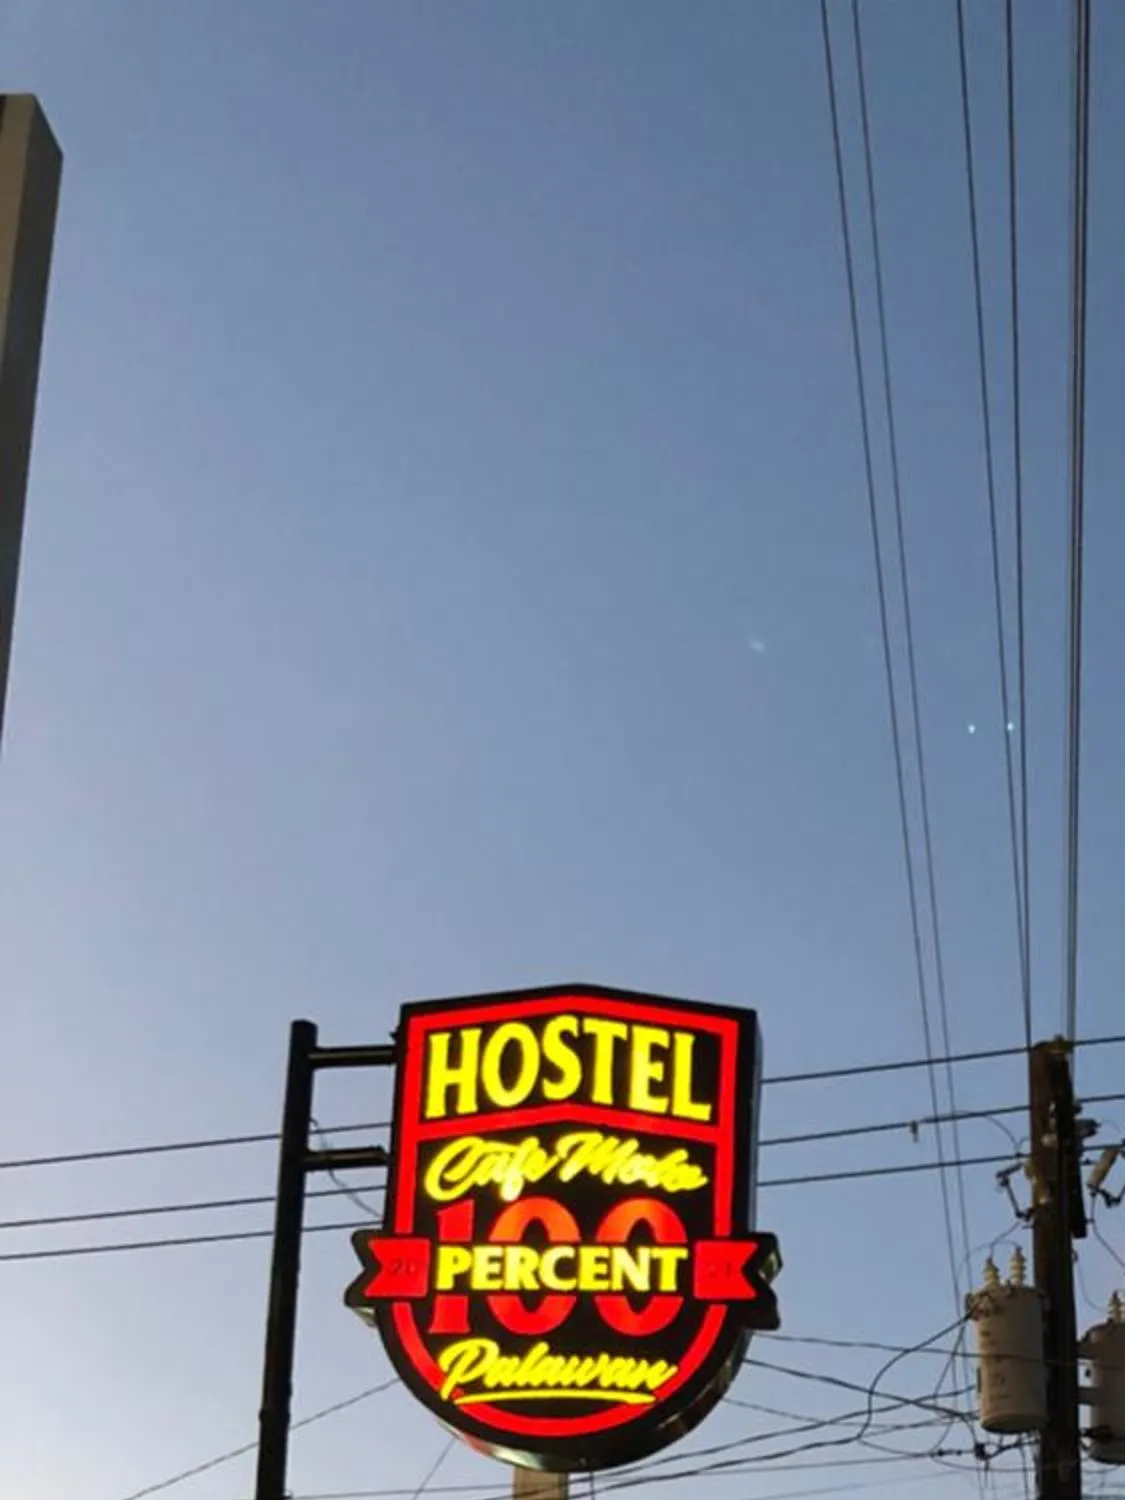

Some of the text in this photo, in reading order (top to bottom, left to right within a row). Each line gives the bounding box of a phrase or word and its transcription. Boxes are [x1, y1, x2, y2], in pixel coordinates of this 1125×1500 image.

[424, 1015, 711, 1121] HOSTEL
[428, 1197, 688, 1336] 100
[435, 1245, 688, 1292] PERCENT
[438, 1337, 679, 1401] Palawan
